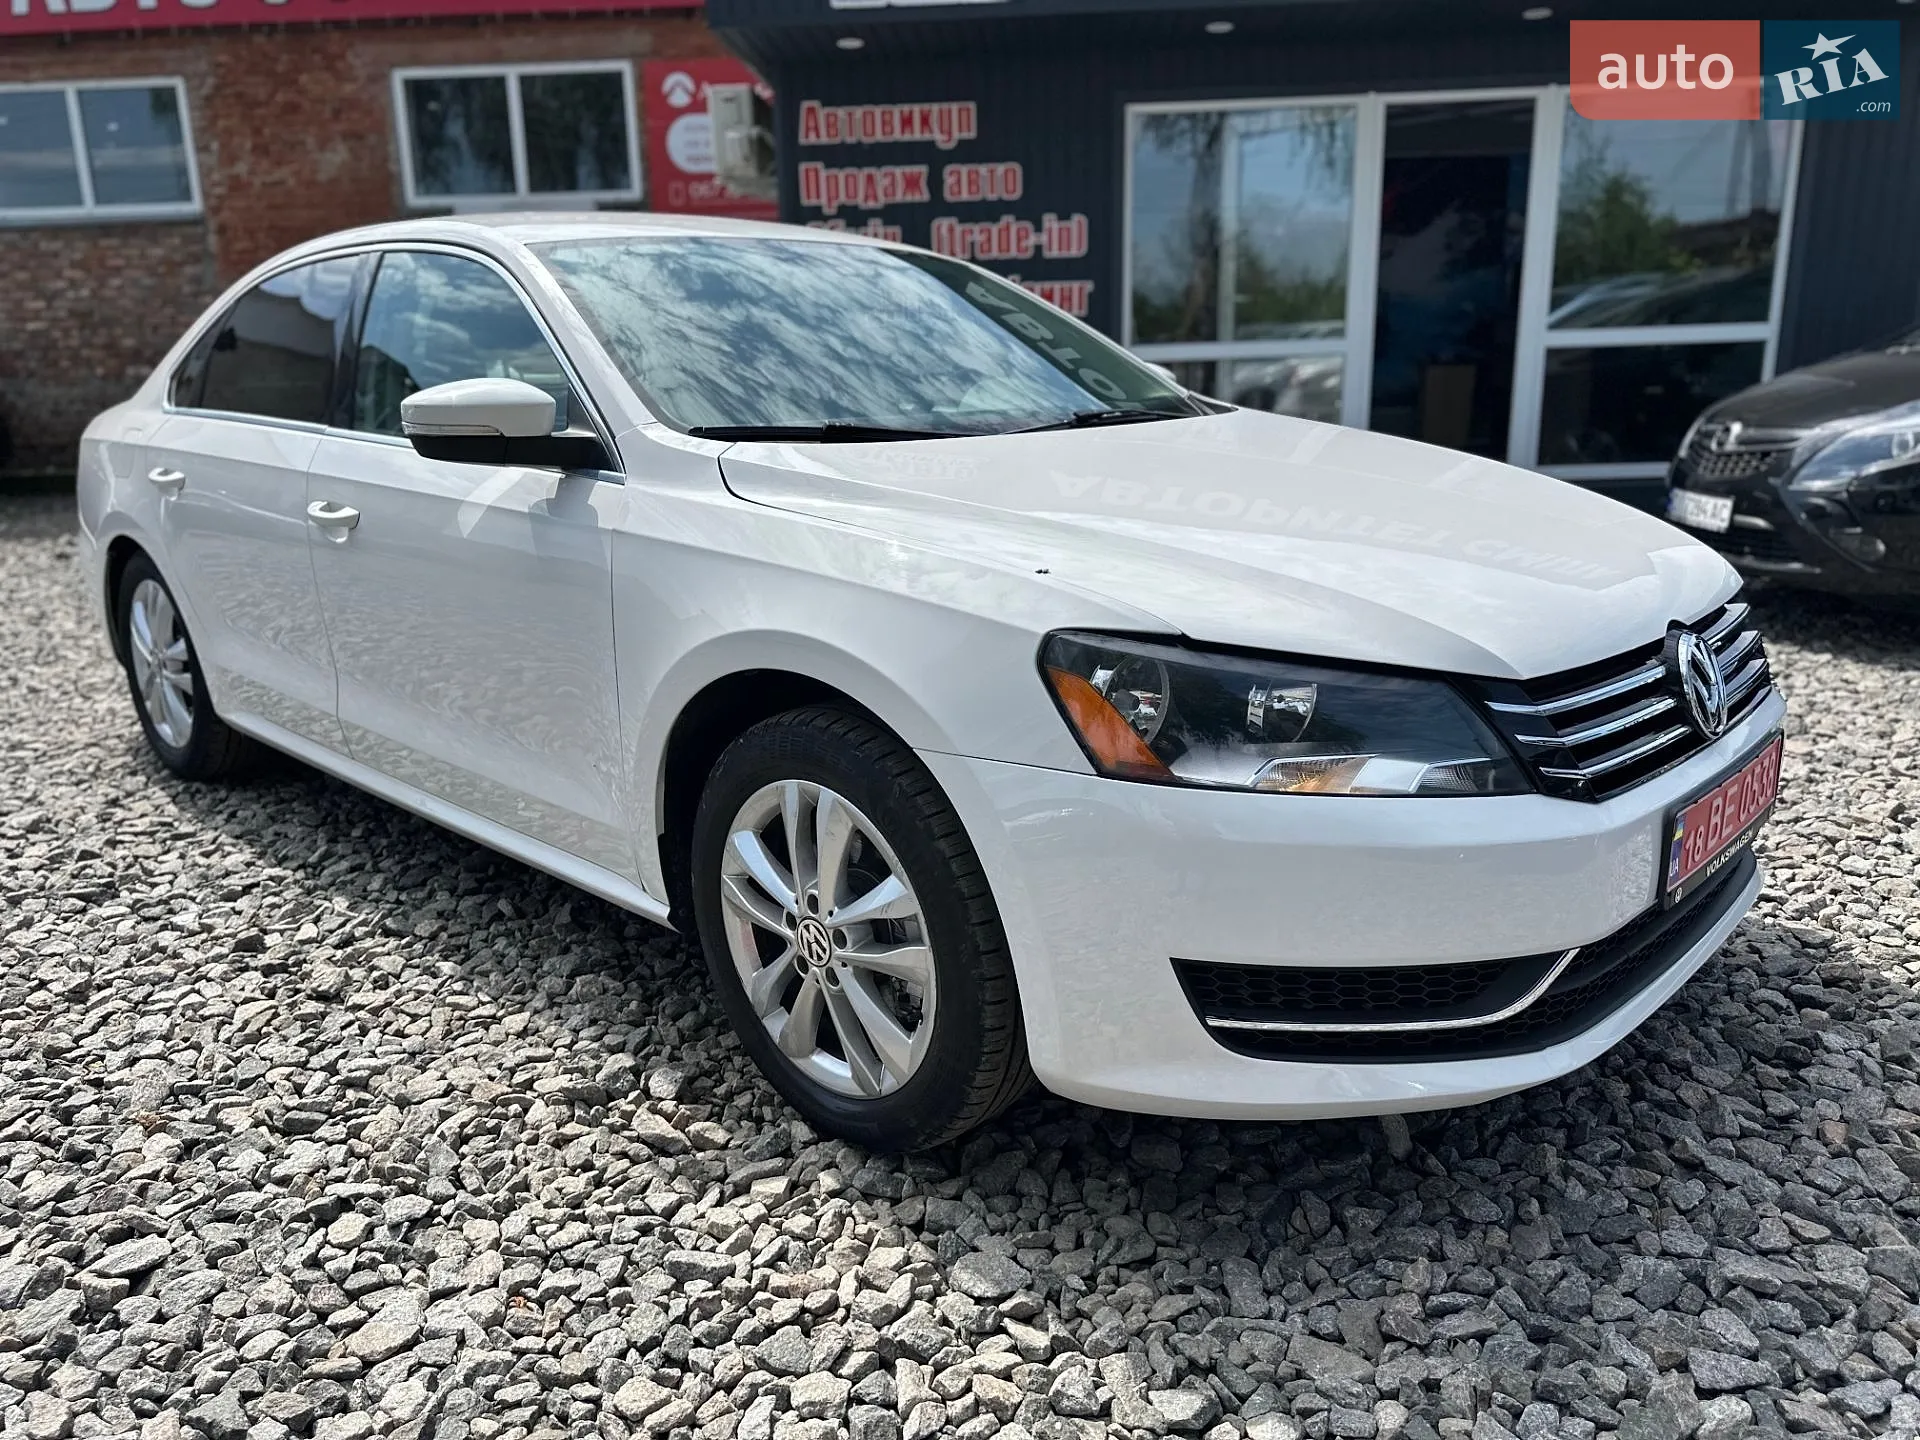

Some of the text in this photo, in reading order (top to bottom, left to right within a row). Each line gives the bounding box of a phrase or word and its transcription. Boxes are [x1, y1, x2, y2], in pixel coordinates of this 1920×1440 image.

[800, 101, 976, 149] Автовикуп
[800, 162, 1021, 213] Продаж авто
[931, 214, 1088, 259] (trade-in)
[1684, 751, 1776, 869] 18 BE 0538
